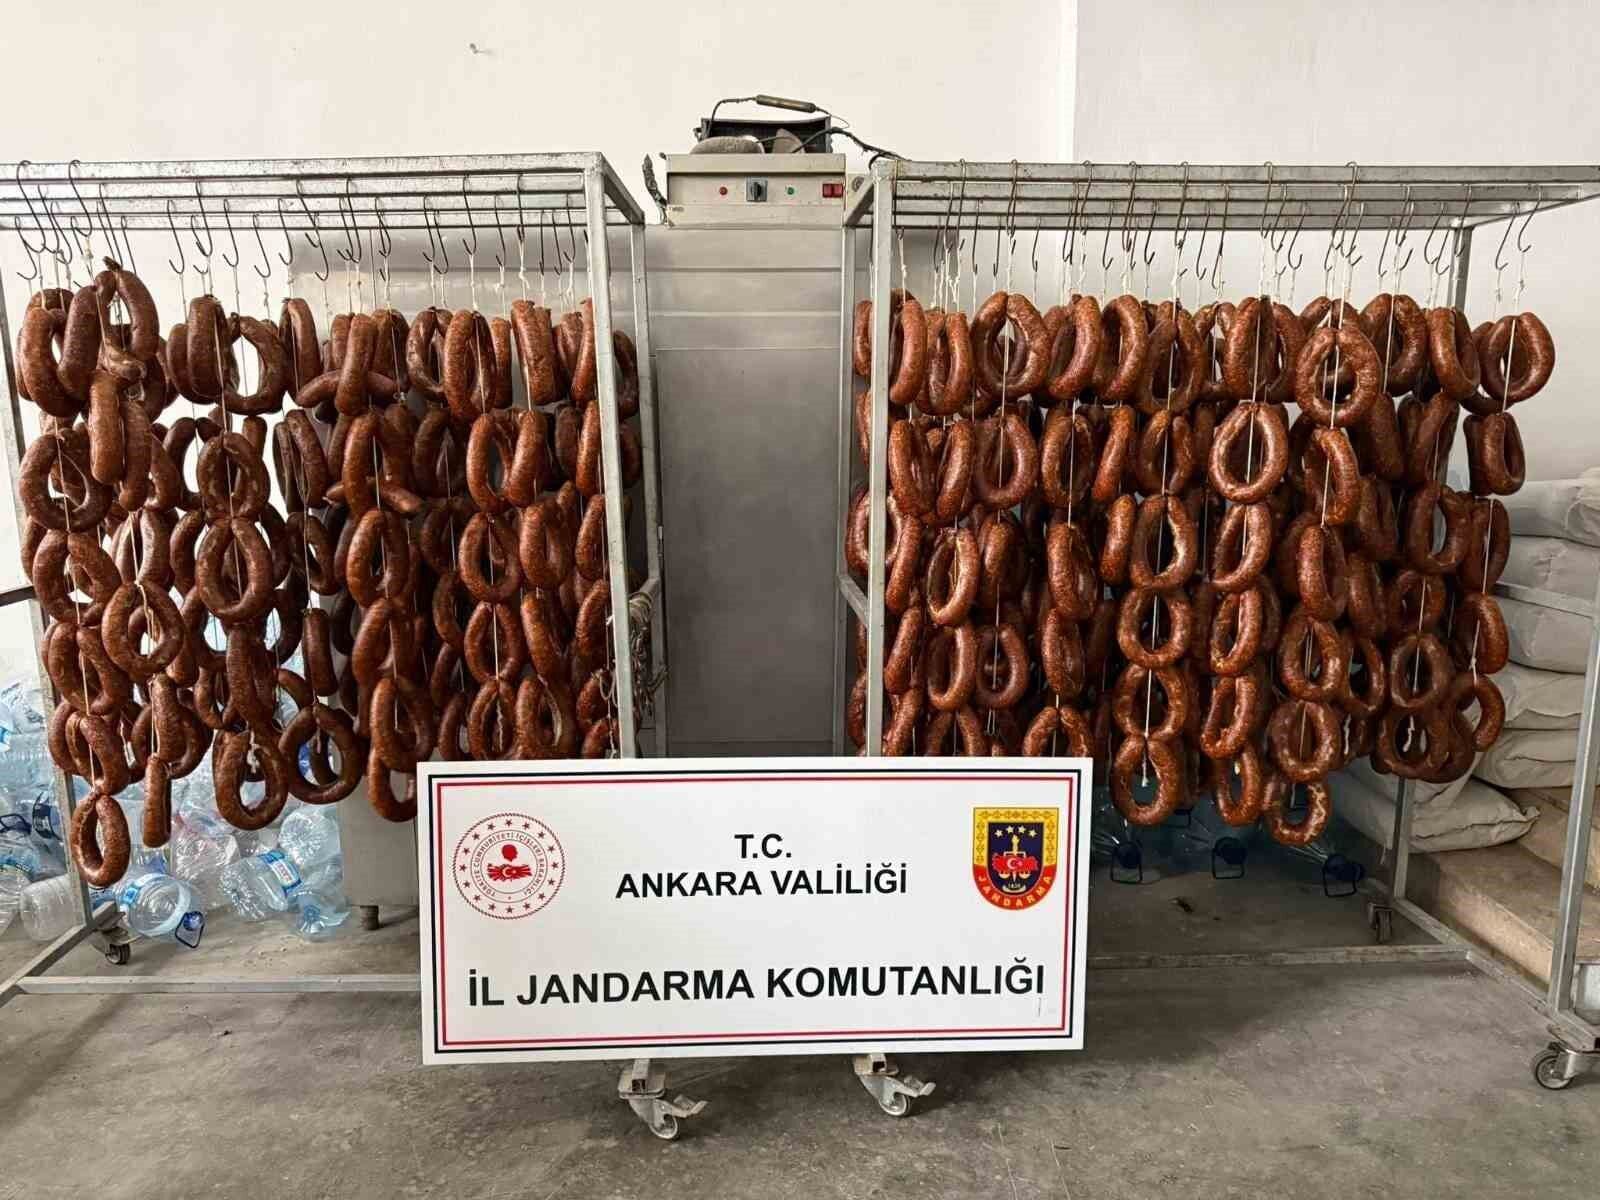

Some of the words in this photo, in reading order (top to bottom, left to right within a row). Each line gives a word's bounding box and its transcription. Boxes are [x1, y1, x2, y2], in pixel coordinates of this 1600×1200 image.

[735, 834, 792, 859] T.C.
[616, 870, 761, 899] ANKARA
[770, 862, 907, 895] VALİLİĞİ
[978, 875, 1052, 908] JANDARMA
[469, 969, 505, 1007] İL
[517, 969, 755, 1006] JANDARMA
[768, 956, 1044, 998] KOMUTANLIĞI
